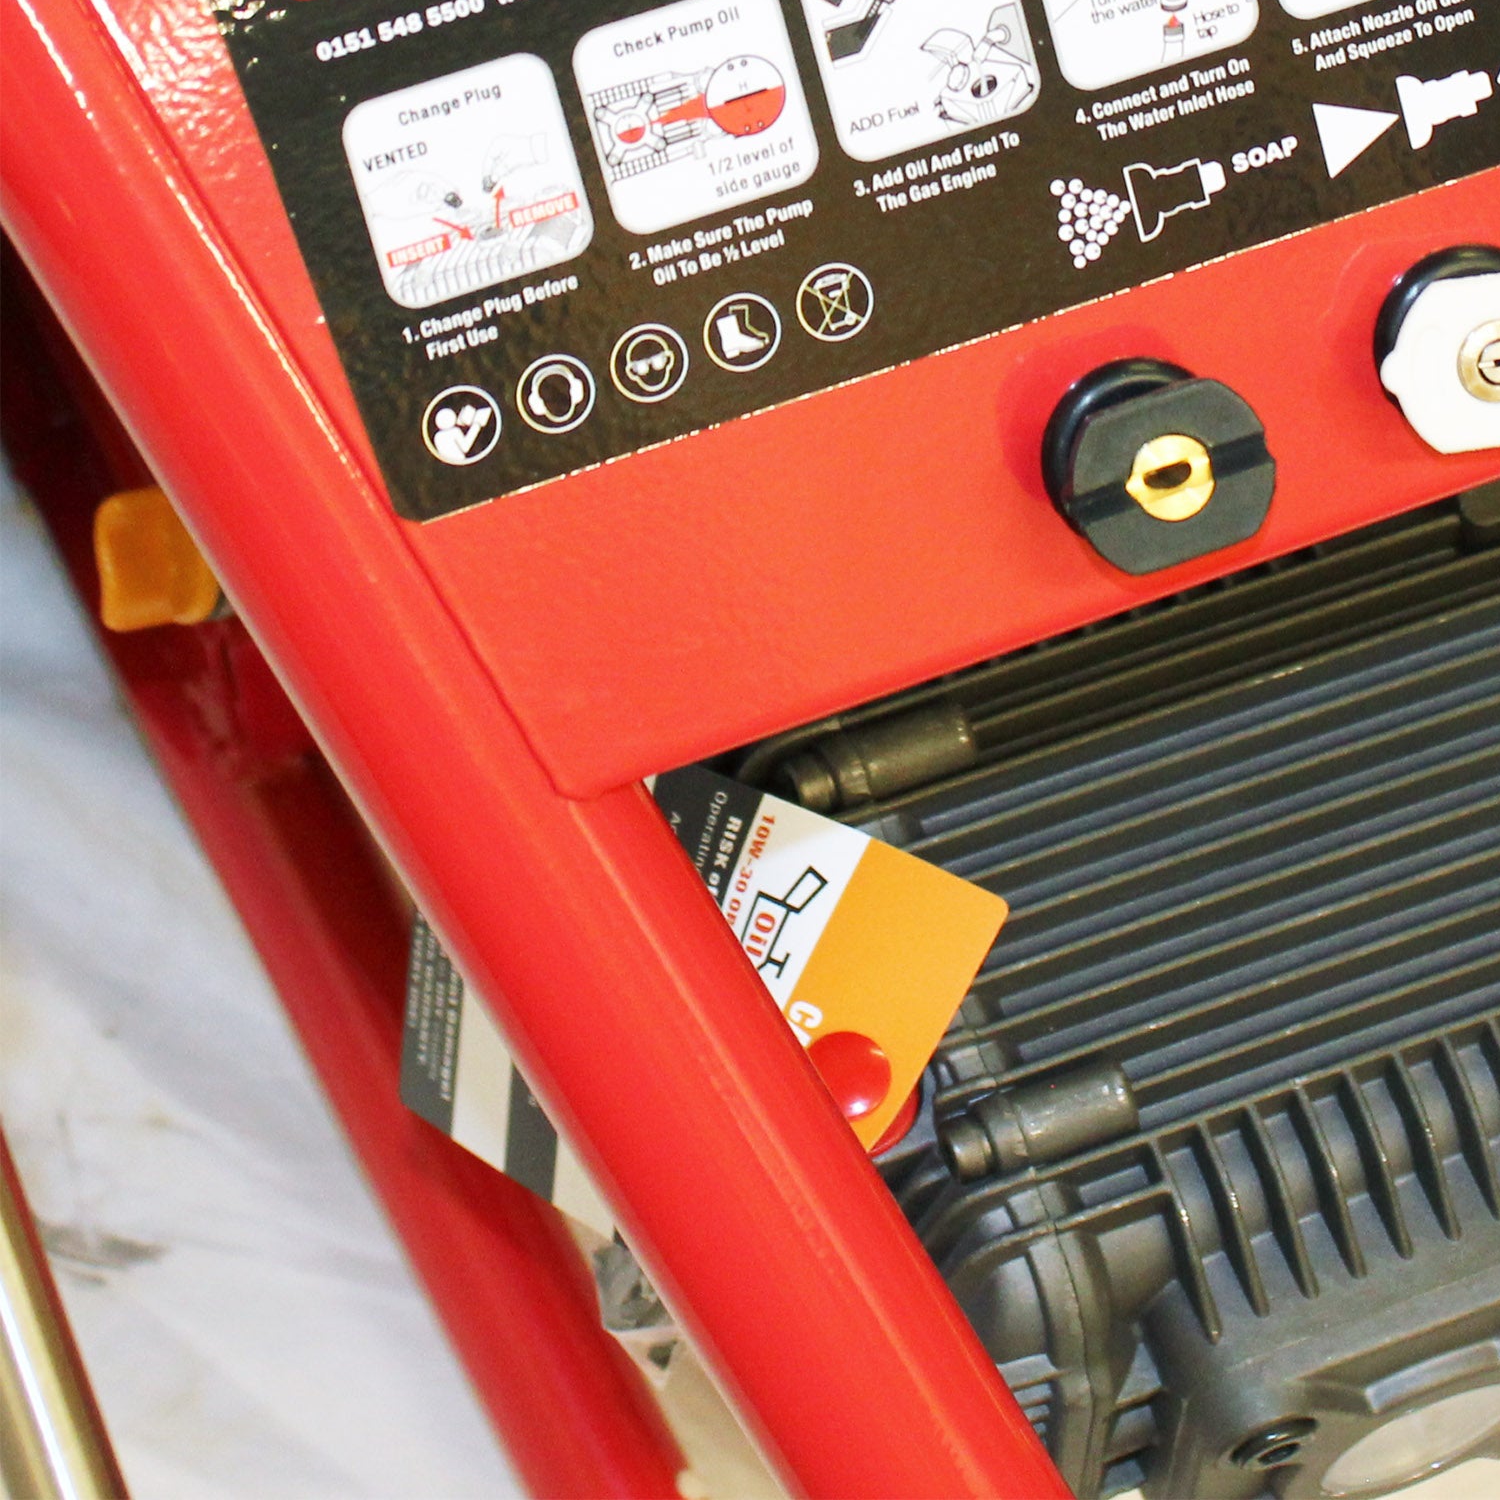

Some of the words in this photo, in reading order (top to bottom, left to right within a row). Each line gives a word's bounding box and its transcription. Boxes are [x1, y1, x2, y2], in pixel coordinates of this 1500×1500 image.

[315, 27, 376, 62] 0151
[376, 11, 424, 42] 548
[612, 31, 664, 57] Check
[666, 17, 714, 40] Pump
[717, 6, 740, 25] Oil
[1090, 8, 1115, 24] the
[1291, 37, 1309, 55] 5.
[1309, 20, 1362, 50] Attach
[1361, 4, 1415, 33] Nozzle
[1315, 46, 1347, 72] And
[1346, 28, 1413, 61] Squeeze
[1412, 20, 1433, 39] To
[1433, 8, 1475, 32] Open
[397, 97, 460, 126] Change
[463, 84, 502, 104] Plug
[849, 112, 884, 134] ADD
[887, 101, 920, 122] Fuel
[363, 141, 428, 172] VENTED
[708, 156, 733, 176] 1/2
[736, 143, 775, 167] level
[778, 136, 794, 154] of
[715, 177, 748, 197] side
[752, 161, 801, 189] gauge
[853, 178, 871, 197] 3.
[872, 166, 905, 192] Add
[904, 158, 929, 180] Oil
[930, 147, 963, 173] And
[962, 135, 999, 162] Fuel
[999, 130, 1020, 149] To
[1231, 135, 1298, 173] SOAP
[875, 191, 908, 213] The
[908, 181, 941, 203] Gas
[940, 163, 997, 192] Engine
[628, 251, 647, 270] 2.
[646, 237, 693, 264] Make
[692, 224, 733, 249] Sure
[733, 214, 765, 235] The
[764, 198, 814, 226] Pump
[652, 263, 678, 286] Oil
[676, 258, 699, 277] To
[698, 251, 722, 271] Be
[739, 227, 785, 258] Level
[401, 326, 420, 344] 1.
[419, 306, 483, 338] Change
[482, 293, 523, 318] Plug
[521, 274, 579, 305] Before
[425, 333, 467, 361] First
[465, 325, 499, 347] Use
[713, 815, 743, 869] RISK
[735, 813, 776, 893] 10W-30
[745, 912, 776, 959] Oil
